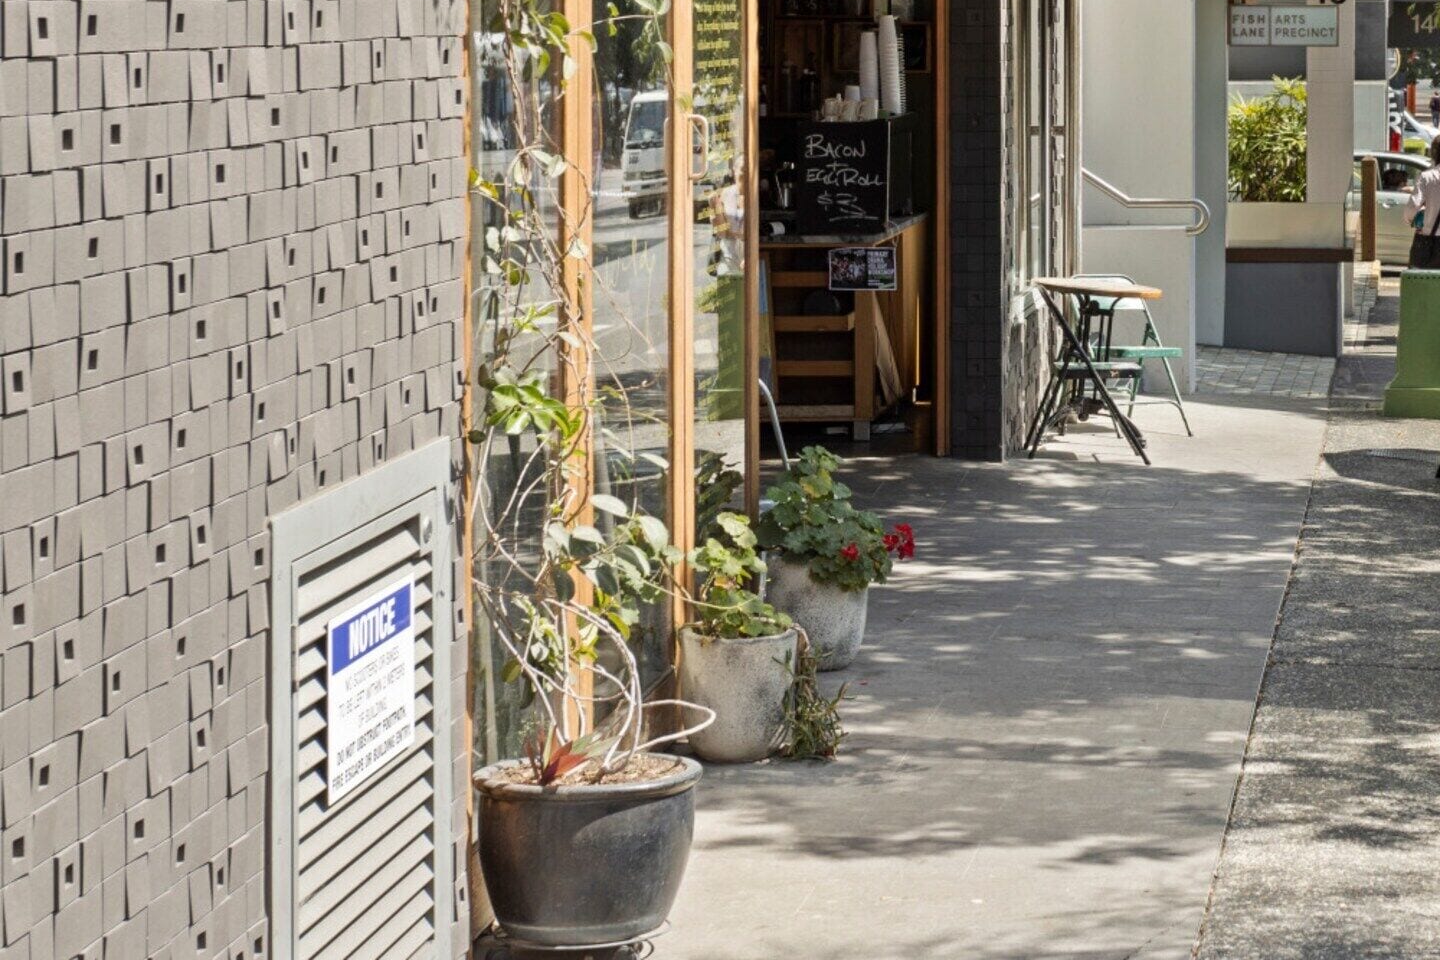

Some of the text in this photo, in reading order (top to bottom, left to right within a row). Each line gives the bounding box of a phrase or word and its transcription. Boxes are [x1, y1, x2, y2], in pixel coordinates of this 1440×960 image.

[1232, 14, 1266, 25] FISH
[1275, 14, 1306, 25] ARTS
[1232, 27, 1266, 38] LANE
[1275, 27, 1336, 38] PRECINCT
[804, 134, 865, 158] BACON
[806, 168, 839, 187] EGG
[348, 596, 396, 660] NOTICE
[337, 748, 344, 766] DO
[345, 740, 356, 758] NOT
[356, 721, 381, 751] OBSTRUCT
[332, 772, 344, 791] FIRE
[344, 756, 364, 783] ESCAPE
[365, 751, 372, 768] OR
[373, 734, 396, 762] BUILDING
